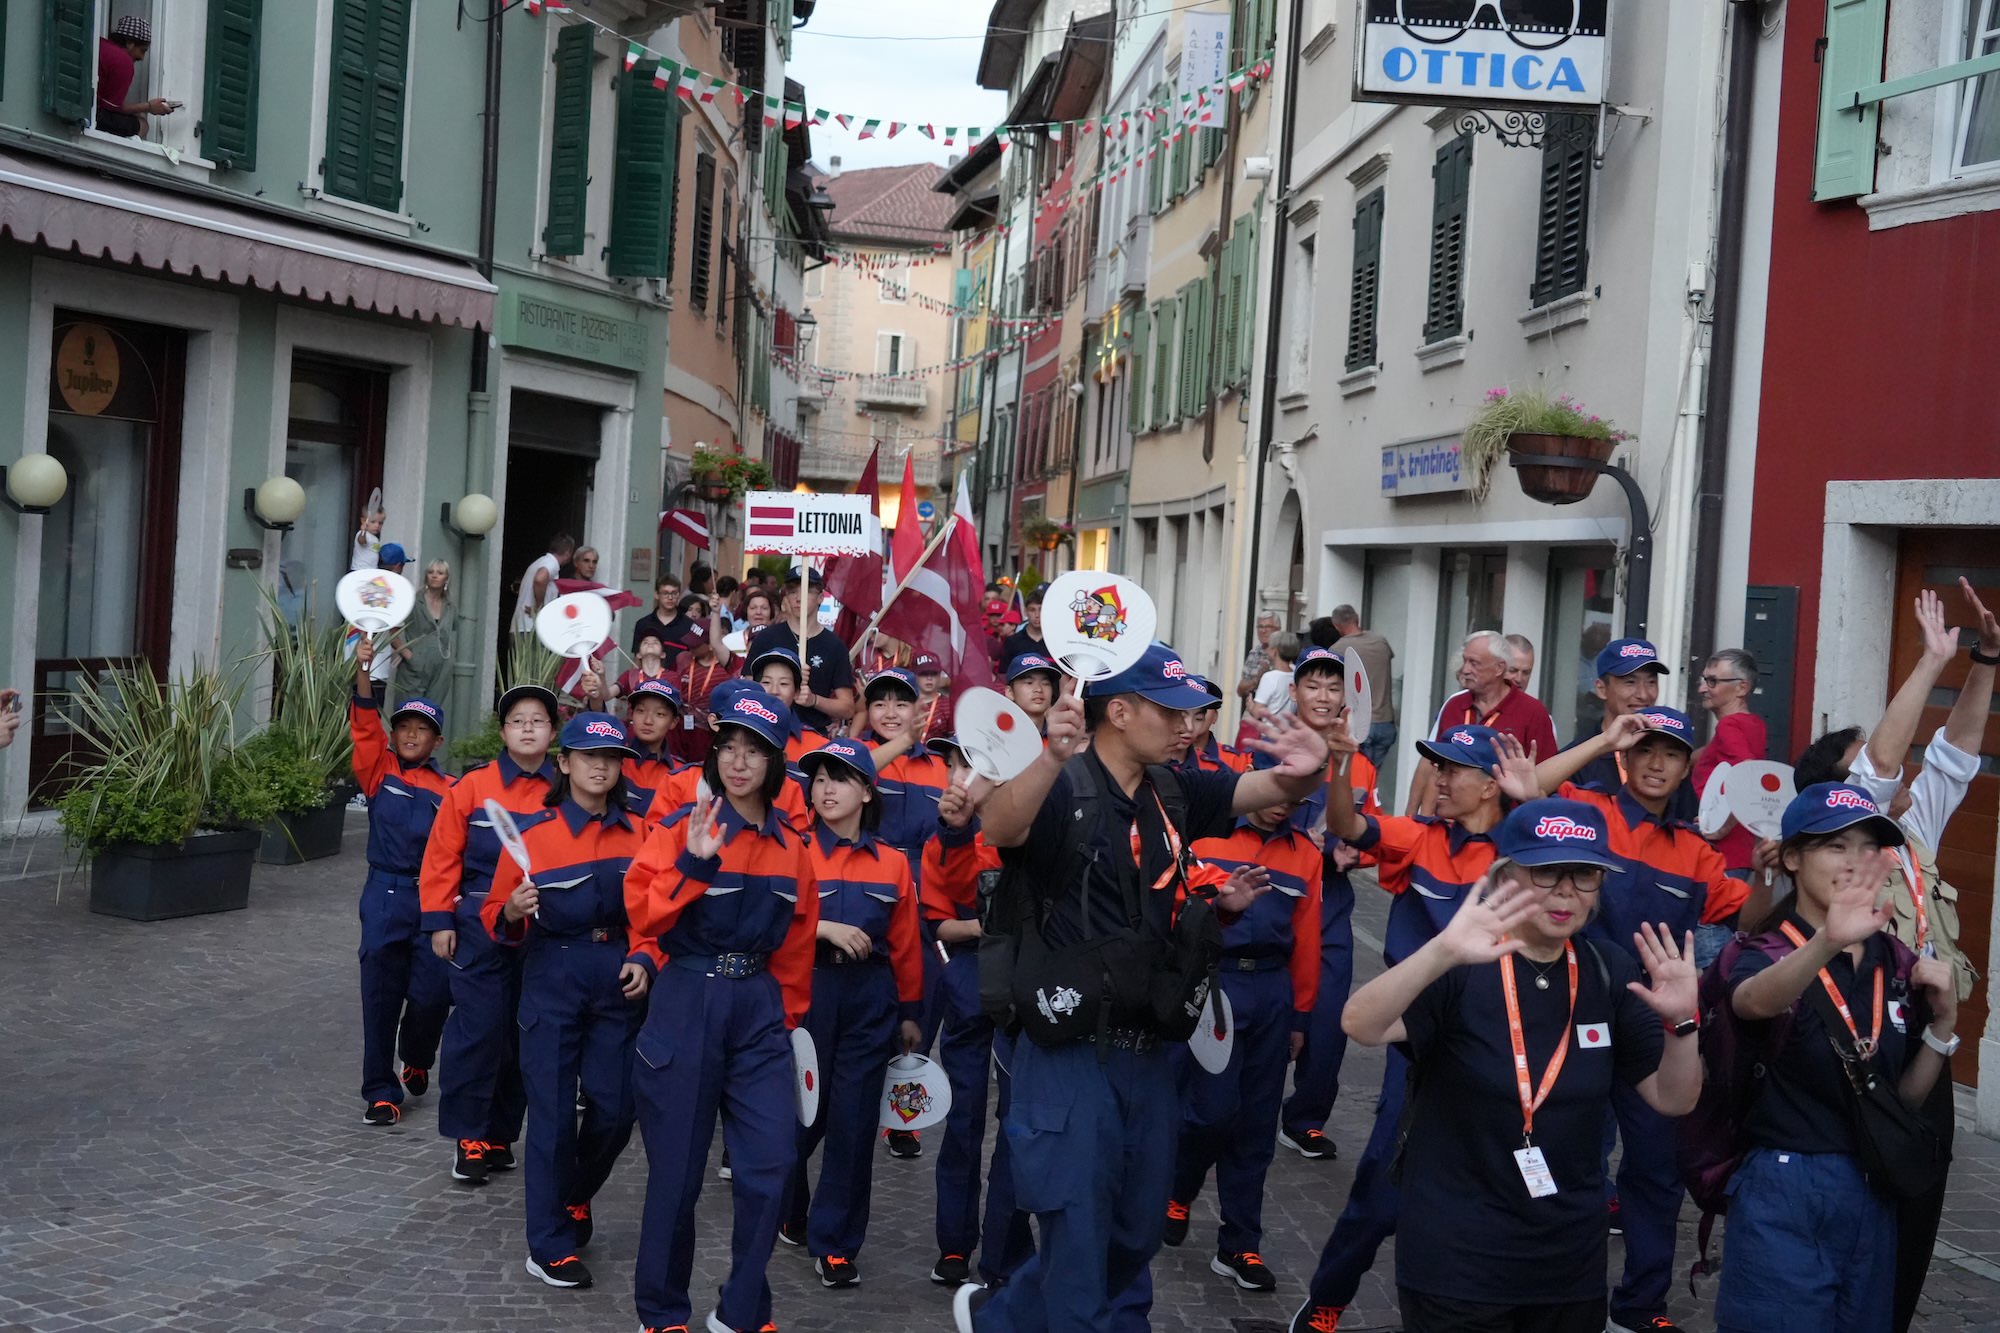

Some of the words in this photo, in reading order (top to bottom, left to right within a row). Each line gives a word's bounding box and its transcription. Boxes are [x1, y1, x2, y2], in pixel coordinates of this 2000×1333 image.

[1186, 28, 1199, 93] AGENZI
[1383, 47, 1586, 93] OTTICA
[519, 301, 577, 334] RISTORANTE
[581, 314, 618, 344] PIZZERIA
[64, 368, 113, 396] Jupiler
[1409, 445, 1459, 482] trintinag
[798, 512, 862, 535] LETTONIA
[1620, 644, 1655, 657] Japan
[1163, 660, 1187, 680] Jap
[640, 681, 673, 694] Japan
[402, 701, 436, 716] Japan
[734, 698, 778, 724] Japan
[586, 721, 624, 740] Japan
[1825, 789, 1879, 813] Japan
[1535, 816, 1597, 842] Japan
